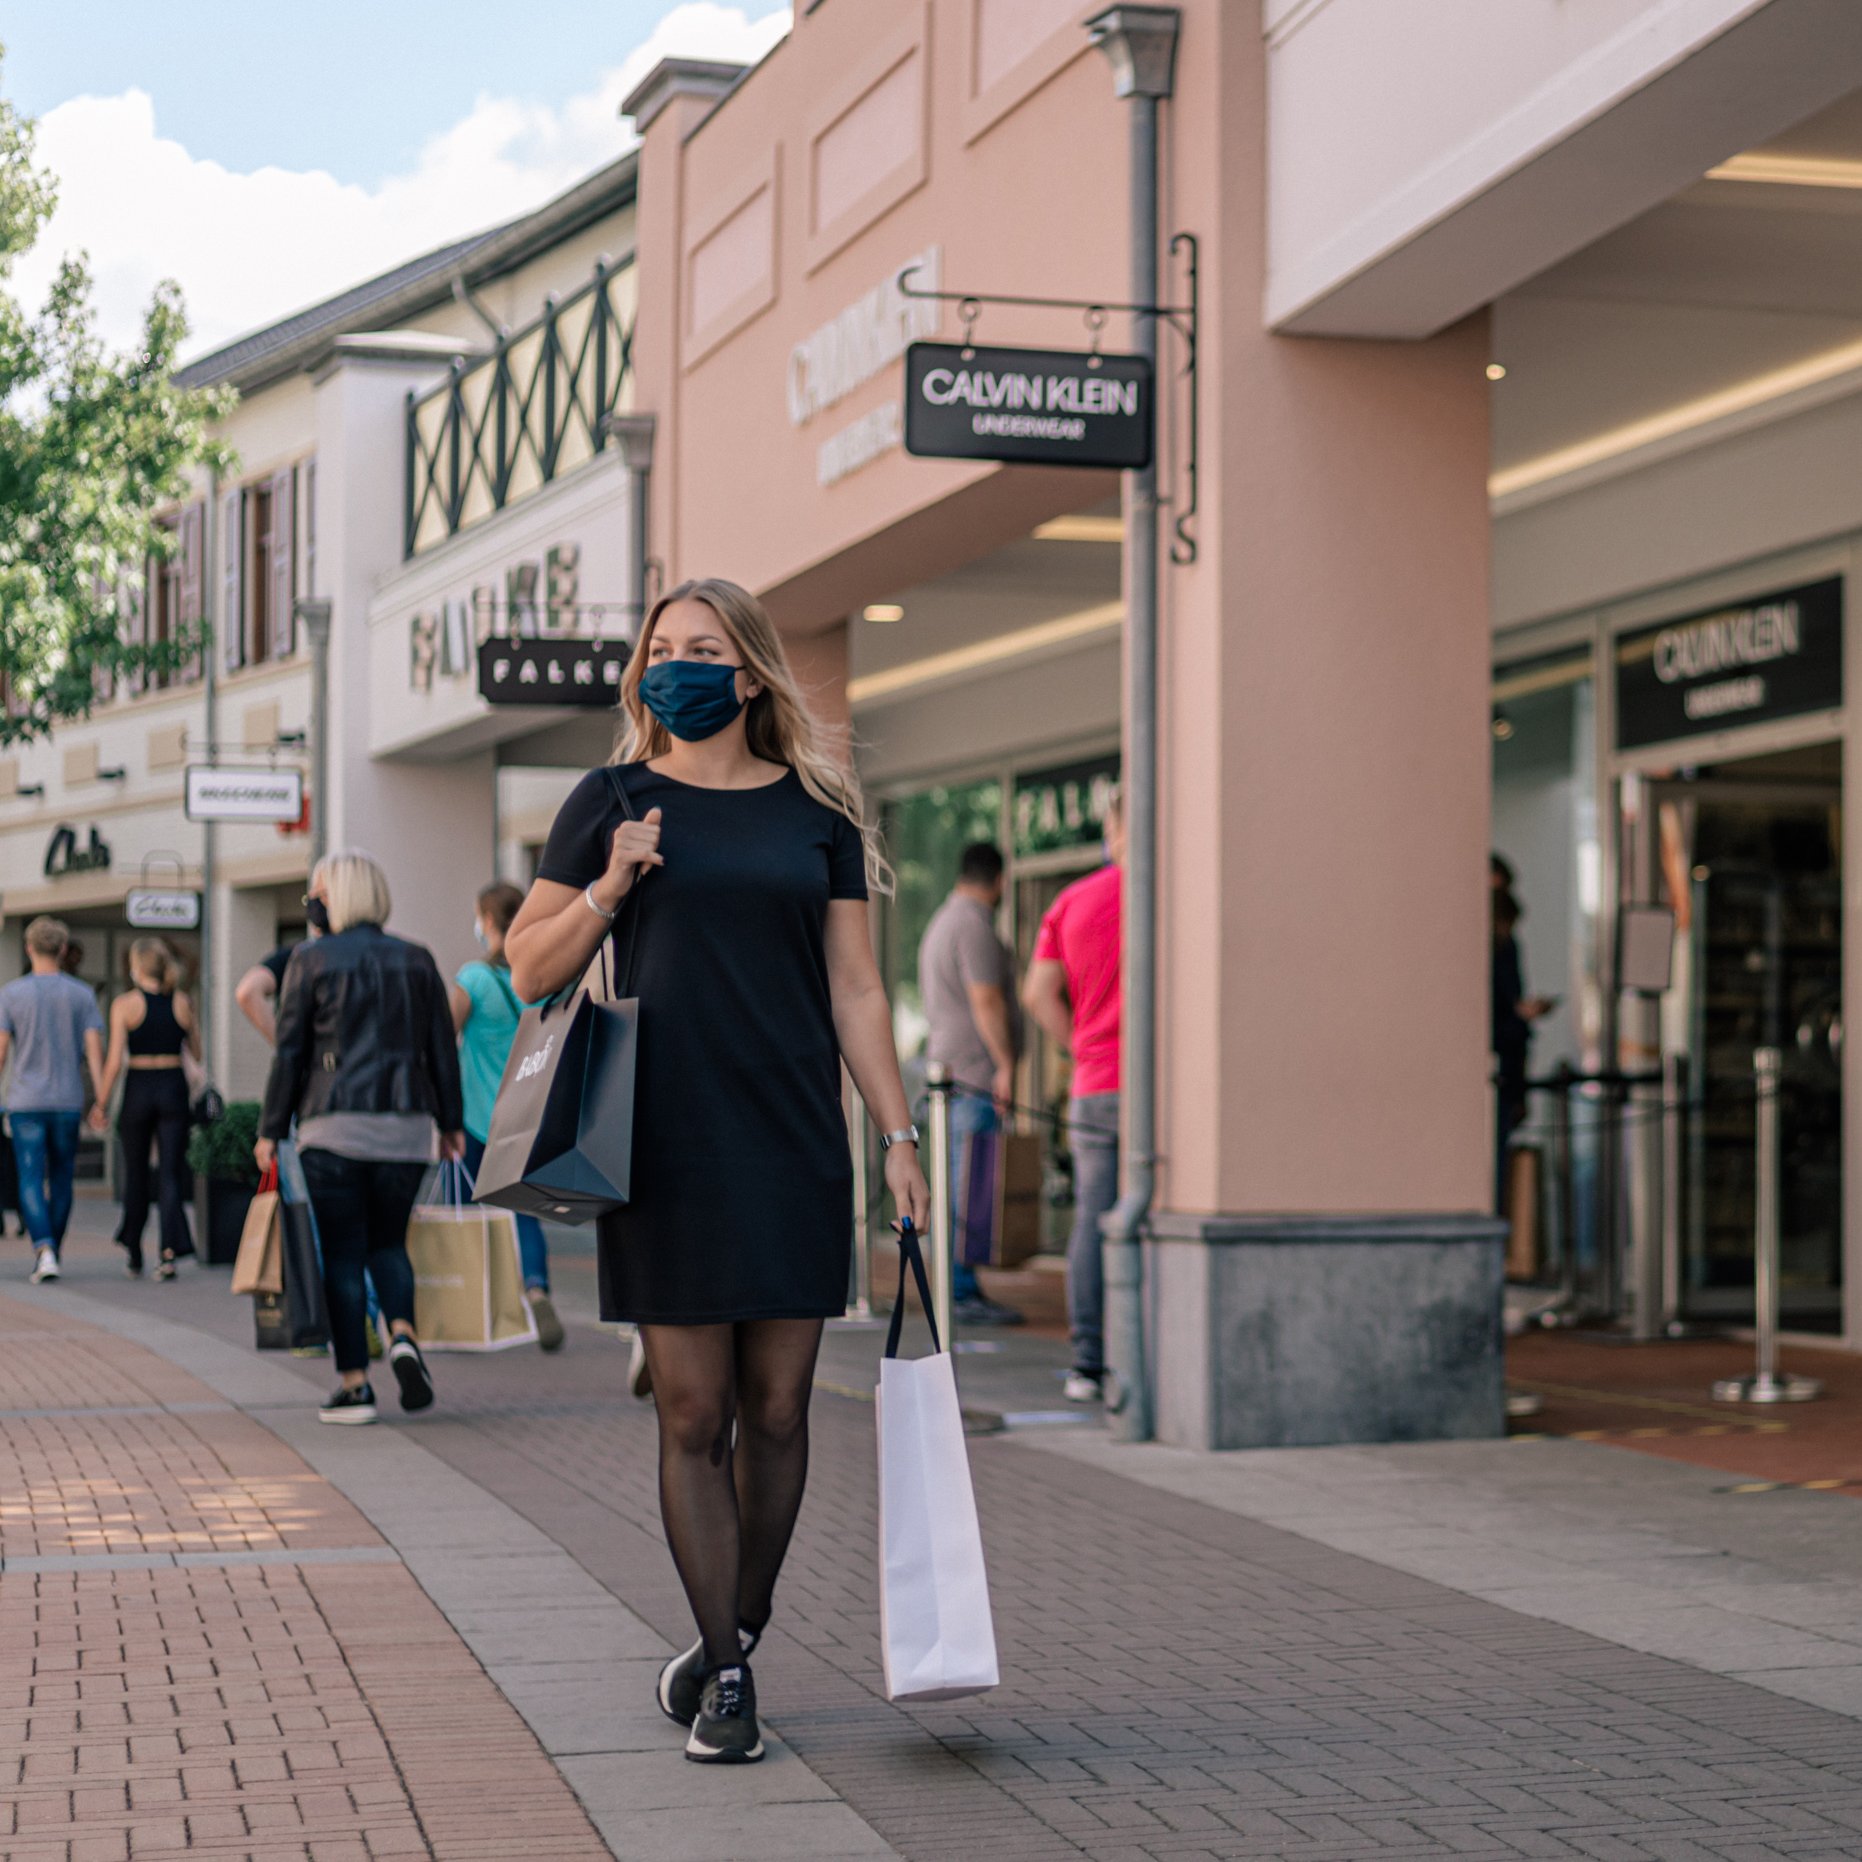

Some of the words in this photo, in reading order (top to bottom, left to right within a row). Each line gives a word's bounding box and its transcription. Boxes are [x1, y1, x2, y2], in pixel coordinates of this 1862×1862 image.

[922, 368, 1043, 411] CALVIN
[1046, 375, 1138, 416] KLEIN
[972, 412, 1086, 440] UNDERWEAR
[493, 658, 622, 685] FALKE
